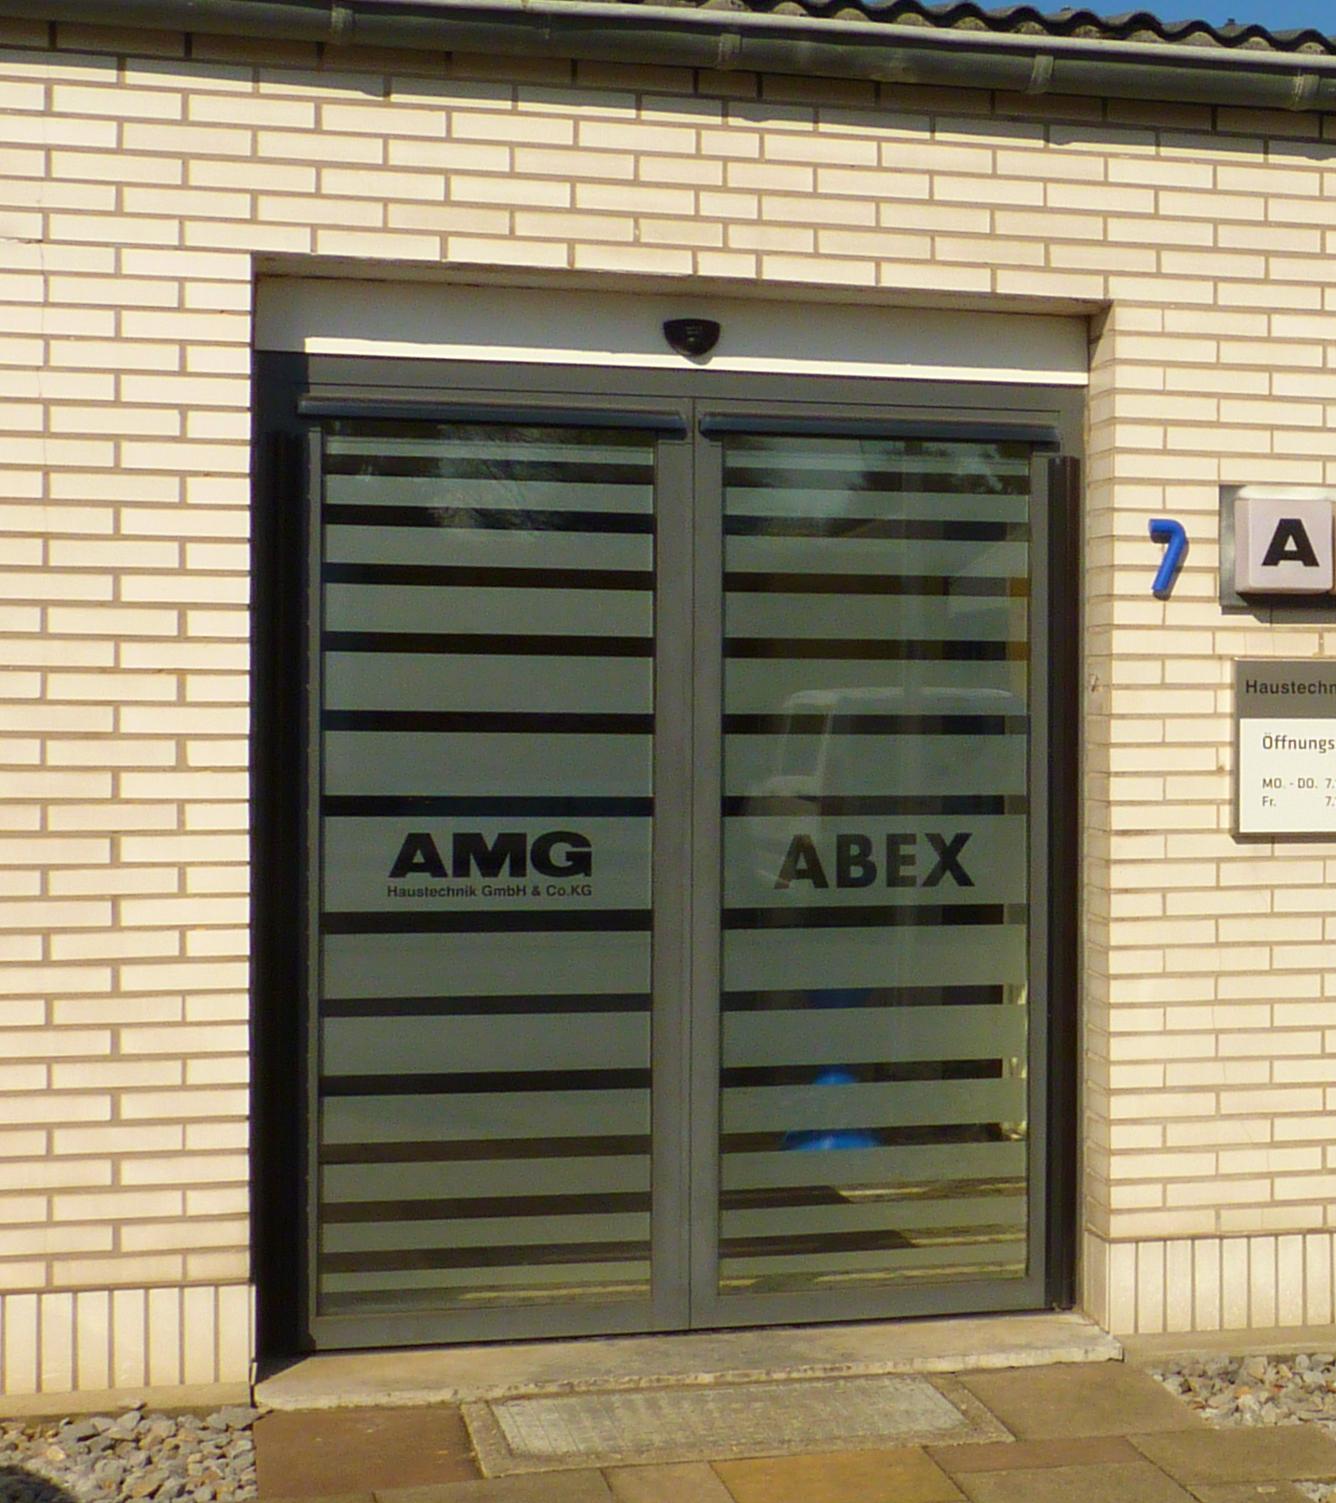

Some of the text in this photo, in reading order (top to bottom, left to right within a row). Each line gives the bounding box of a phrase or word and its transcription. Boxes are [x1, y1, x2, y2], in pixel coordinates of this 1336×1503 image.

[1149, 519, 1186, 596] 7
[1297, 777, 1318, 789] DO.
[1262, 796, 1277, 807] Fr.
[388, 831, 592, 877] AMG
[774, 833, 975, 890] ABEX
[387, 884, 477, 897] Haustechnik
[481, 884, 527, 897] GmbH
[531, 885, 541, 896] &
